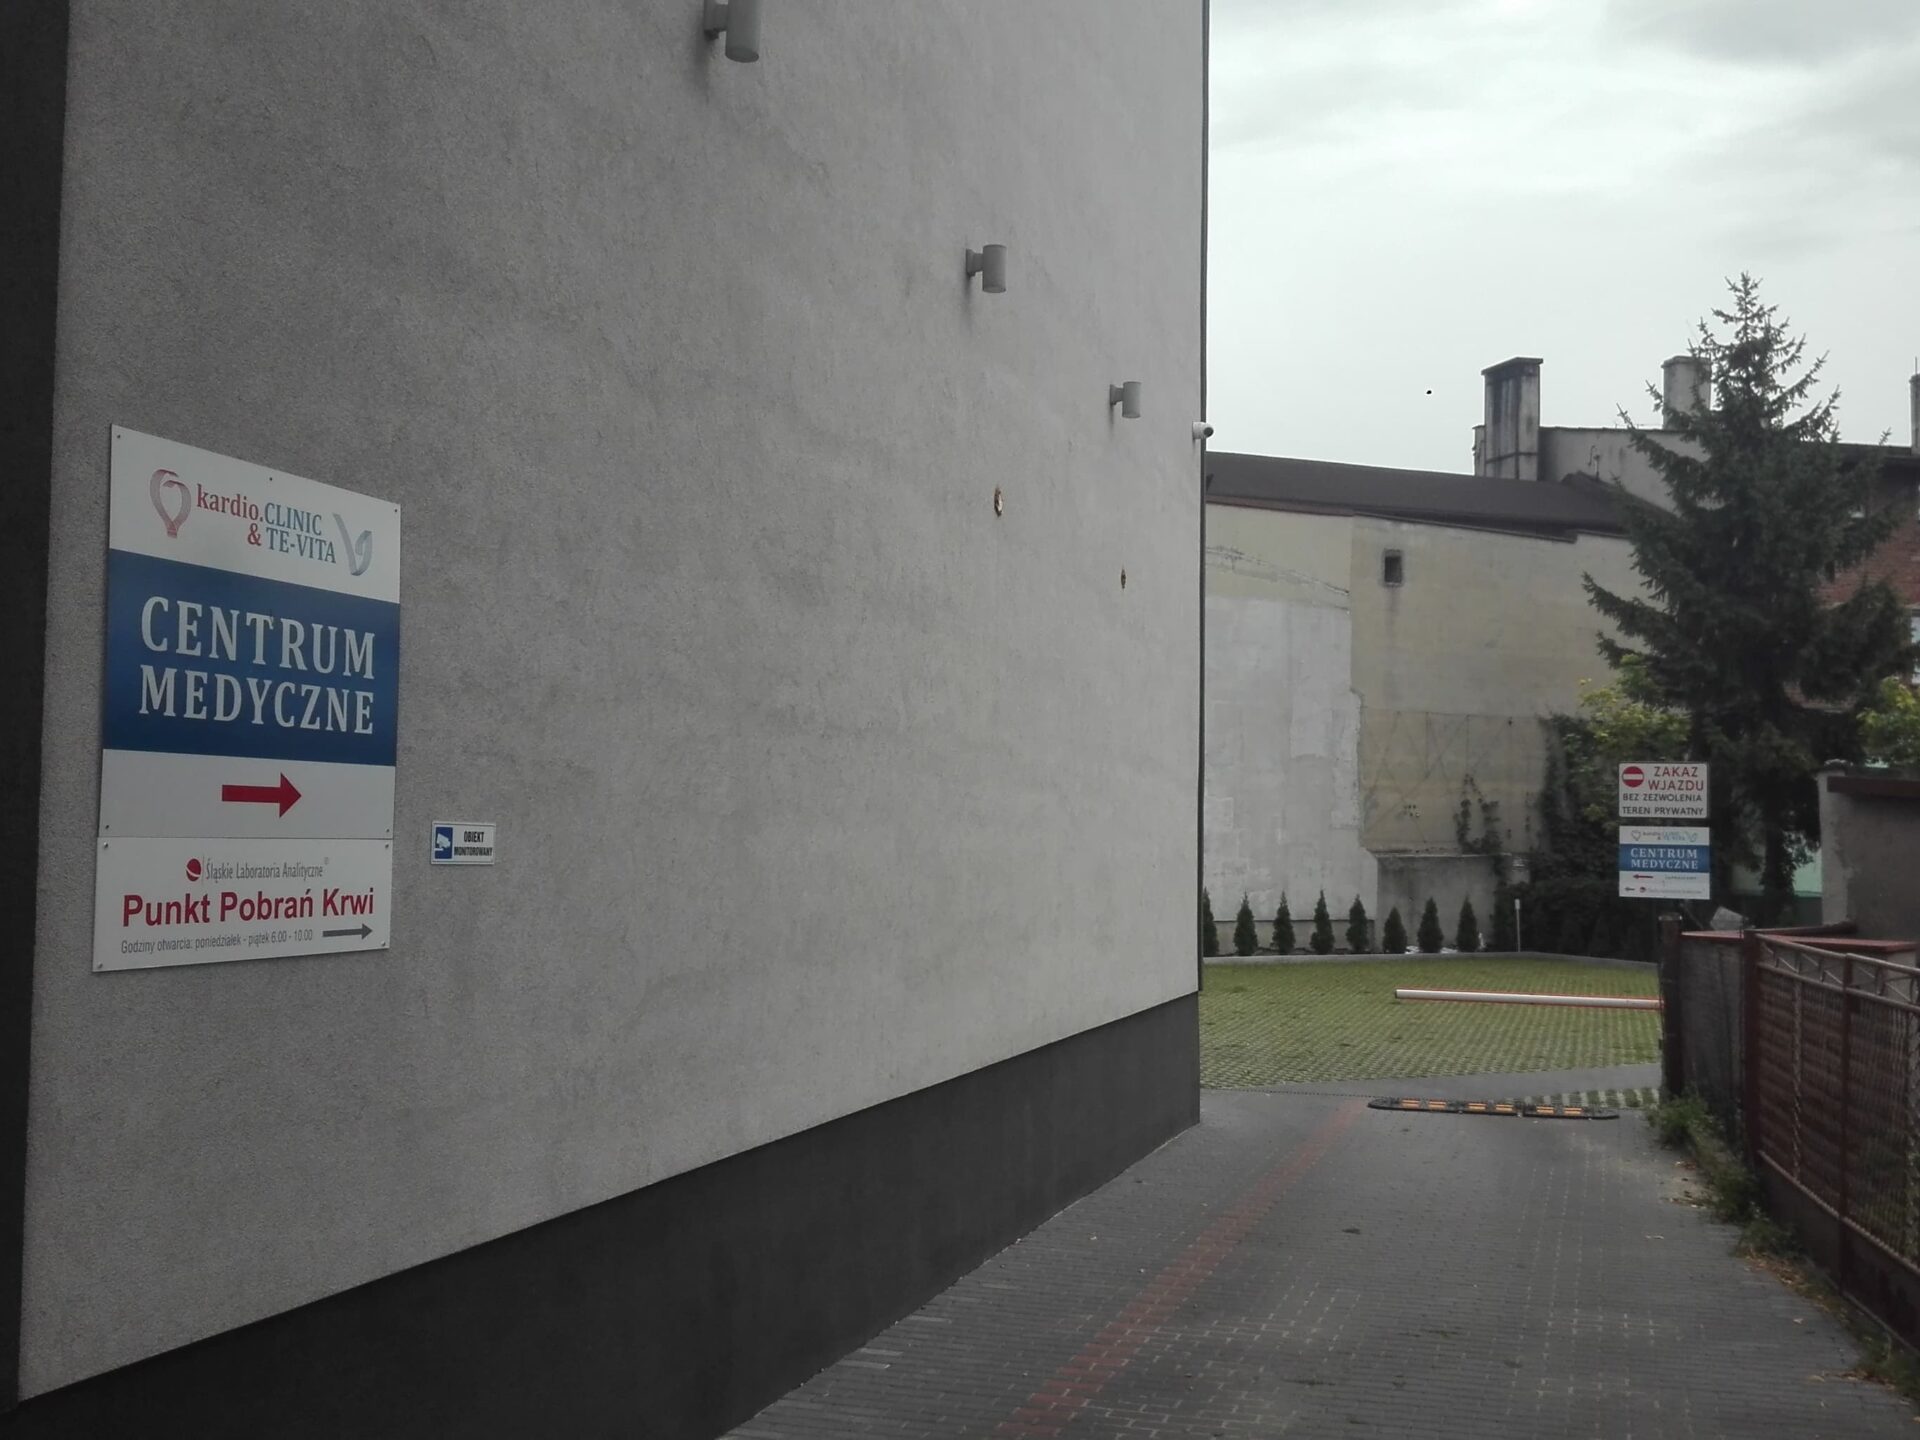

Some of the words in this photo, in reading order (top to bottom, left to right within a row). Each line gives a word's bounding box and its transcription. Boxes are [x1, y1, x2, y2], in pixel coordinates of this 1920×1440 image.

[247, 523, 262, 546] &
[266, 527, 337, 564] TE-VITA
[141, 596, 375, 680] CENTRUM
[139, 664, 373, 734] MEDYCZNE
[1654, 766, 1698, 777] ZAKAZ
[1648, 780, 1704, 791] WJAZDU
[1623, 793, 1639, 801] BEZ
[1643, 793, 1702, 802] ZEZWOLENIA
[1622, 806, 1651, 815] TEREN
[1654, 806, 1704, 816] PRYWATNY
[464, 830, 484, 843] OBIEKT
[1630, 848, 1697, 859] CENTRUM
[206, 858, 233, 883] Śląskie
[236, 861, 280, 879] Laboratoria
[282, 861, 323, 881] Analityczne
[1631, 859, 1698, 870] MEDYCZNE
[122, 893, 211, 928] Punkt
[220, 888, 313, 922] Pobrań
[322, 887, 374, 917] Krwi
[121, 939, 155, 955] Godziny
[157, 937, 193, 951] otwarcia:
[195, 934, 241, 950] poniedziałek
[248, 932, 270, 947] piątek
[271, 930, 287, 944] 6.00
[294, 928, 313, 942] 10.00
